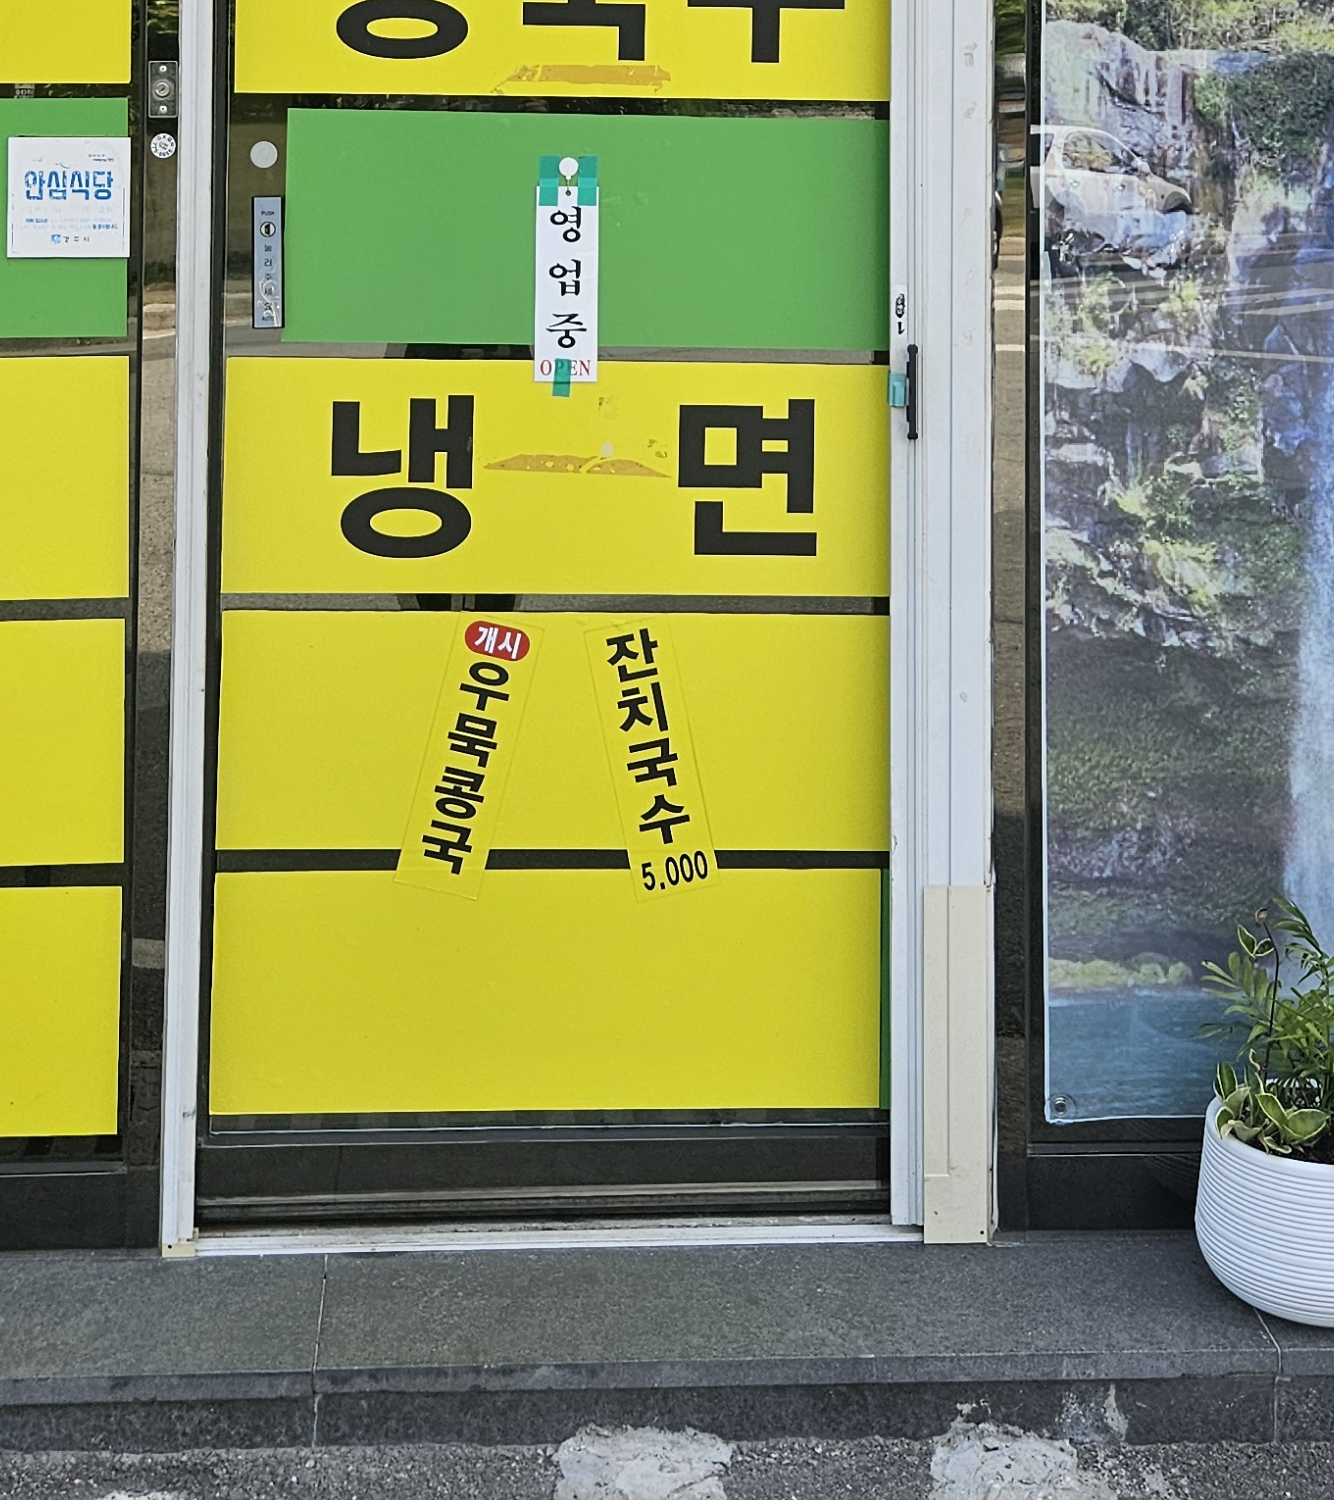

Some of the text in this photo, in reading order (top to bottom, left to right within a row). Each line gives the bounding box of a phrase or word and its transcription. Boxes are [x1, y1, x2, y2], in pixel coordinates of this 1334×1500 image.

[24, 170, 114, 201] 안심식당
[545, 205, 588, 349] 영업중
[540, 359, 592, 376] OPEN
[473, 625, 522, 660] 개시
[605, 627, 691, 845] 잔치국수
[421, 661, 511, 876] 우묵콩국
[641, 850, 709, 891] 5.000
